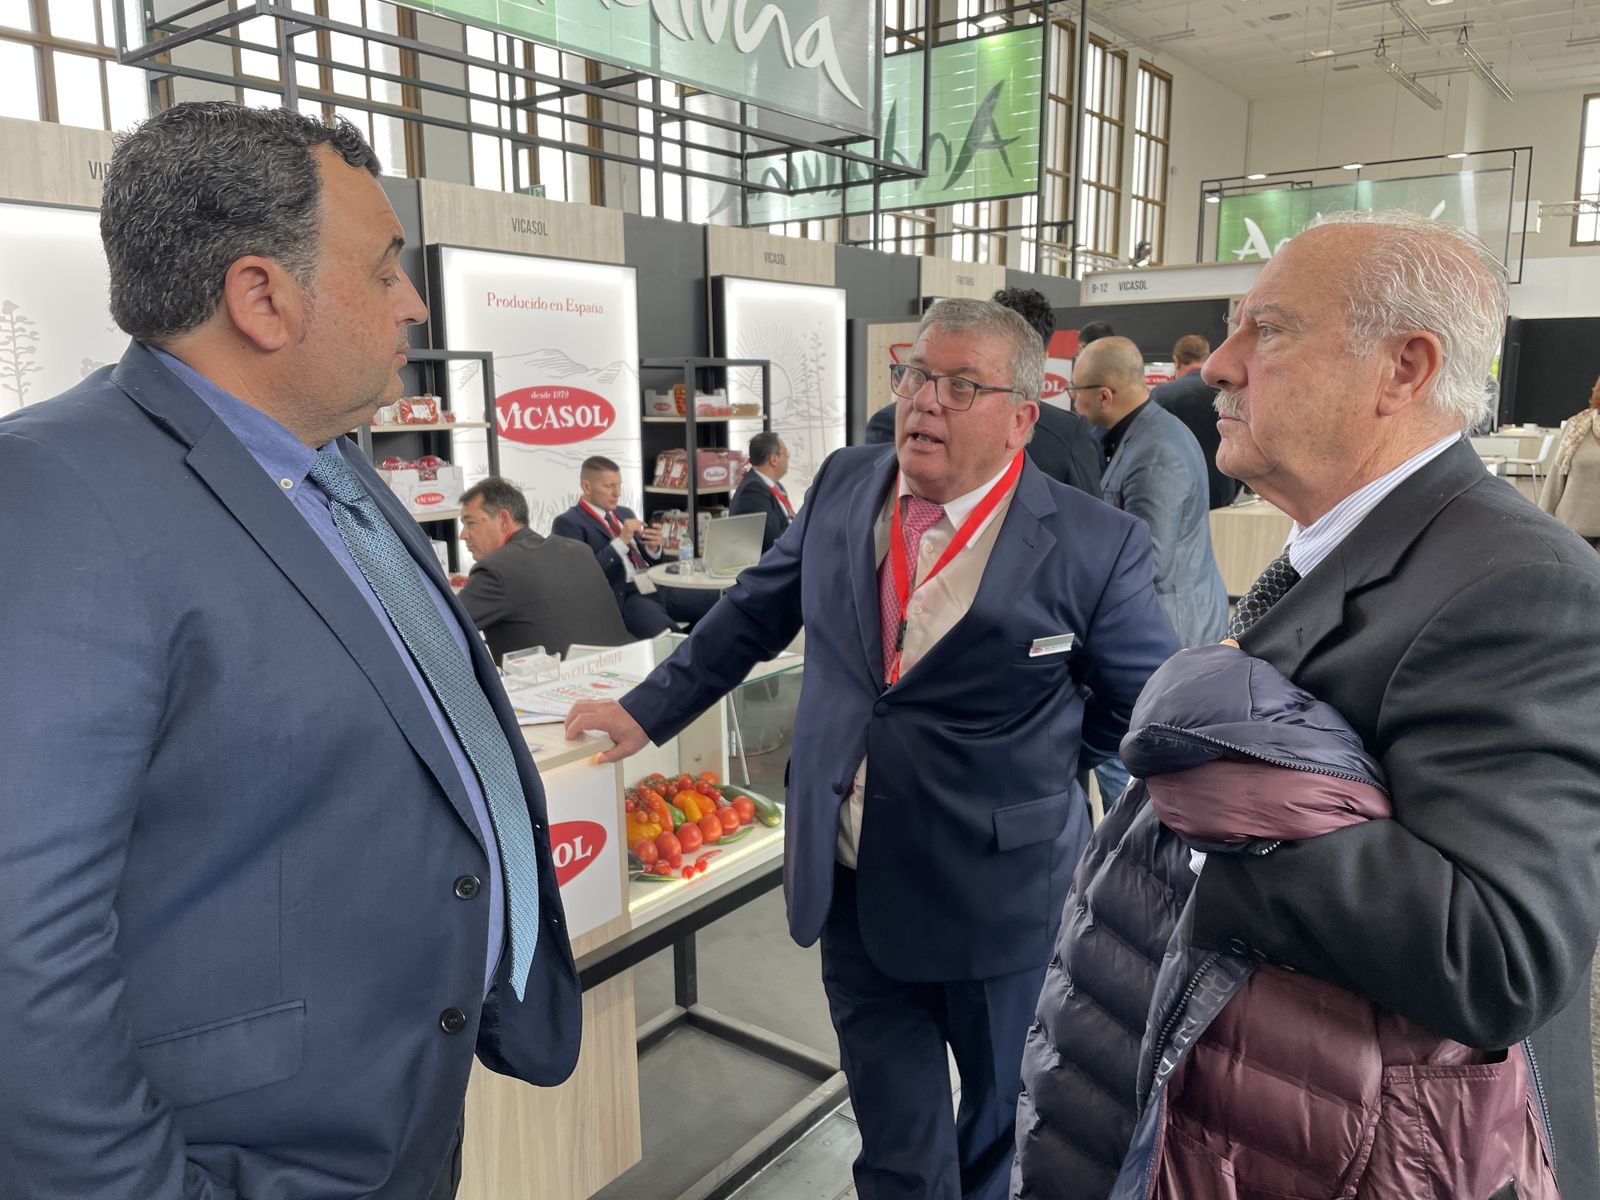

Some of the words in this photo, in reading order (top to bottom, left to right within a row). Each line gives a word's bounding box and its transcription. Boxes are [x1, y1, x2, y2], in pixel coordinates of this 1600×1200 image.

[511, 217, 548, 236] VICASOL
[1118, 280, 1148, 291] VICASOL
[487, 291, 547, 310] Producido
[549, 301, 563, 311] en
[565, 298, 604, 316] España
[531, 391, 552, 399] desde
[552, 390, 569, 399] 1979
